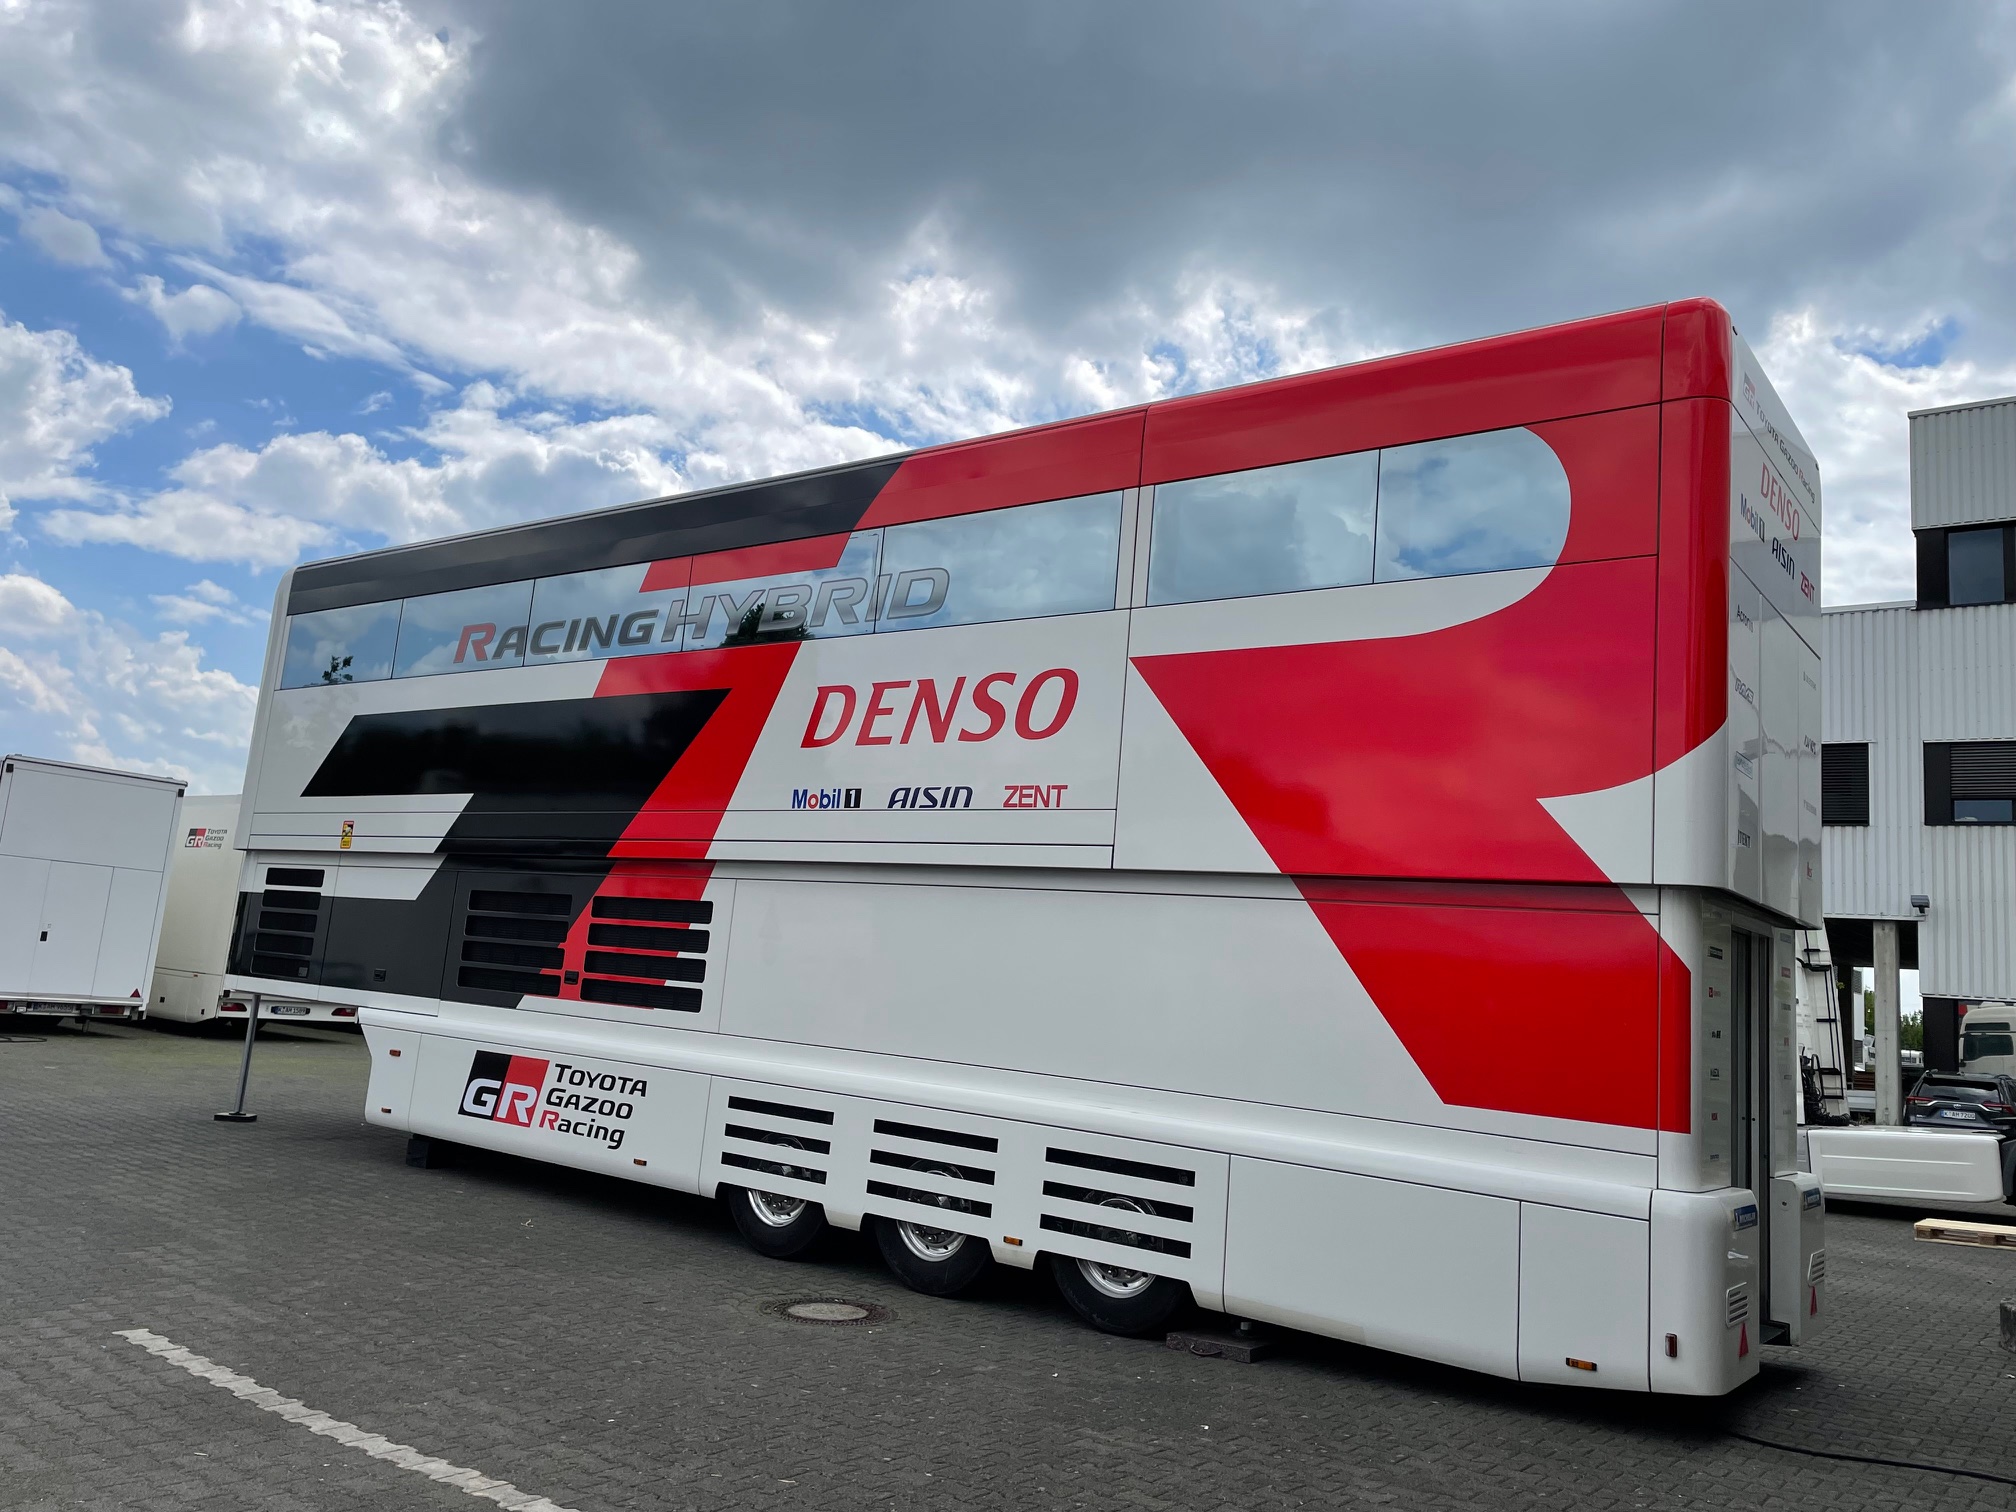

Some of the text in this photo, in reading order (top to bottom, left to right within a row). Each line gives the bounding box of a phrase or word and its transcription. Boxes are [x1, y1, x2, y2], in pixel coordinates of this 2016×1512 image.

[1755, 401, 1779, 445] TOYOTA
[1761, 462, 1800, 540] DENSO
[1740, 493, 1758, 535] Mobil
[1772, 537, 1795, 580] AISIN
[453, 567, 950, 663] RACING HYBRID
[800, 668, 1079, 748] DENSO
[792, 788, 841, 809] Mobil
[887, 785, 973, 809] AISIN
[1003, 784, 1068, 808] ZENT
[185, 836, 204, 847] GR
[203, 842, 223, 850] Racing
[462, 1077, 538, 1124] GR
[554, 1063, 648, 1098] TOYOTA
[545, 1087, 634, 1120] GAZOO
[538, 1109, 626, 1150] Racing
